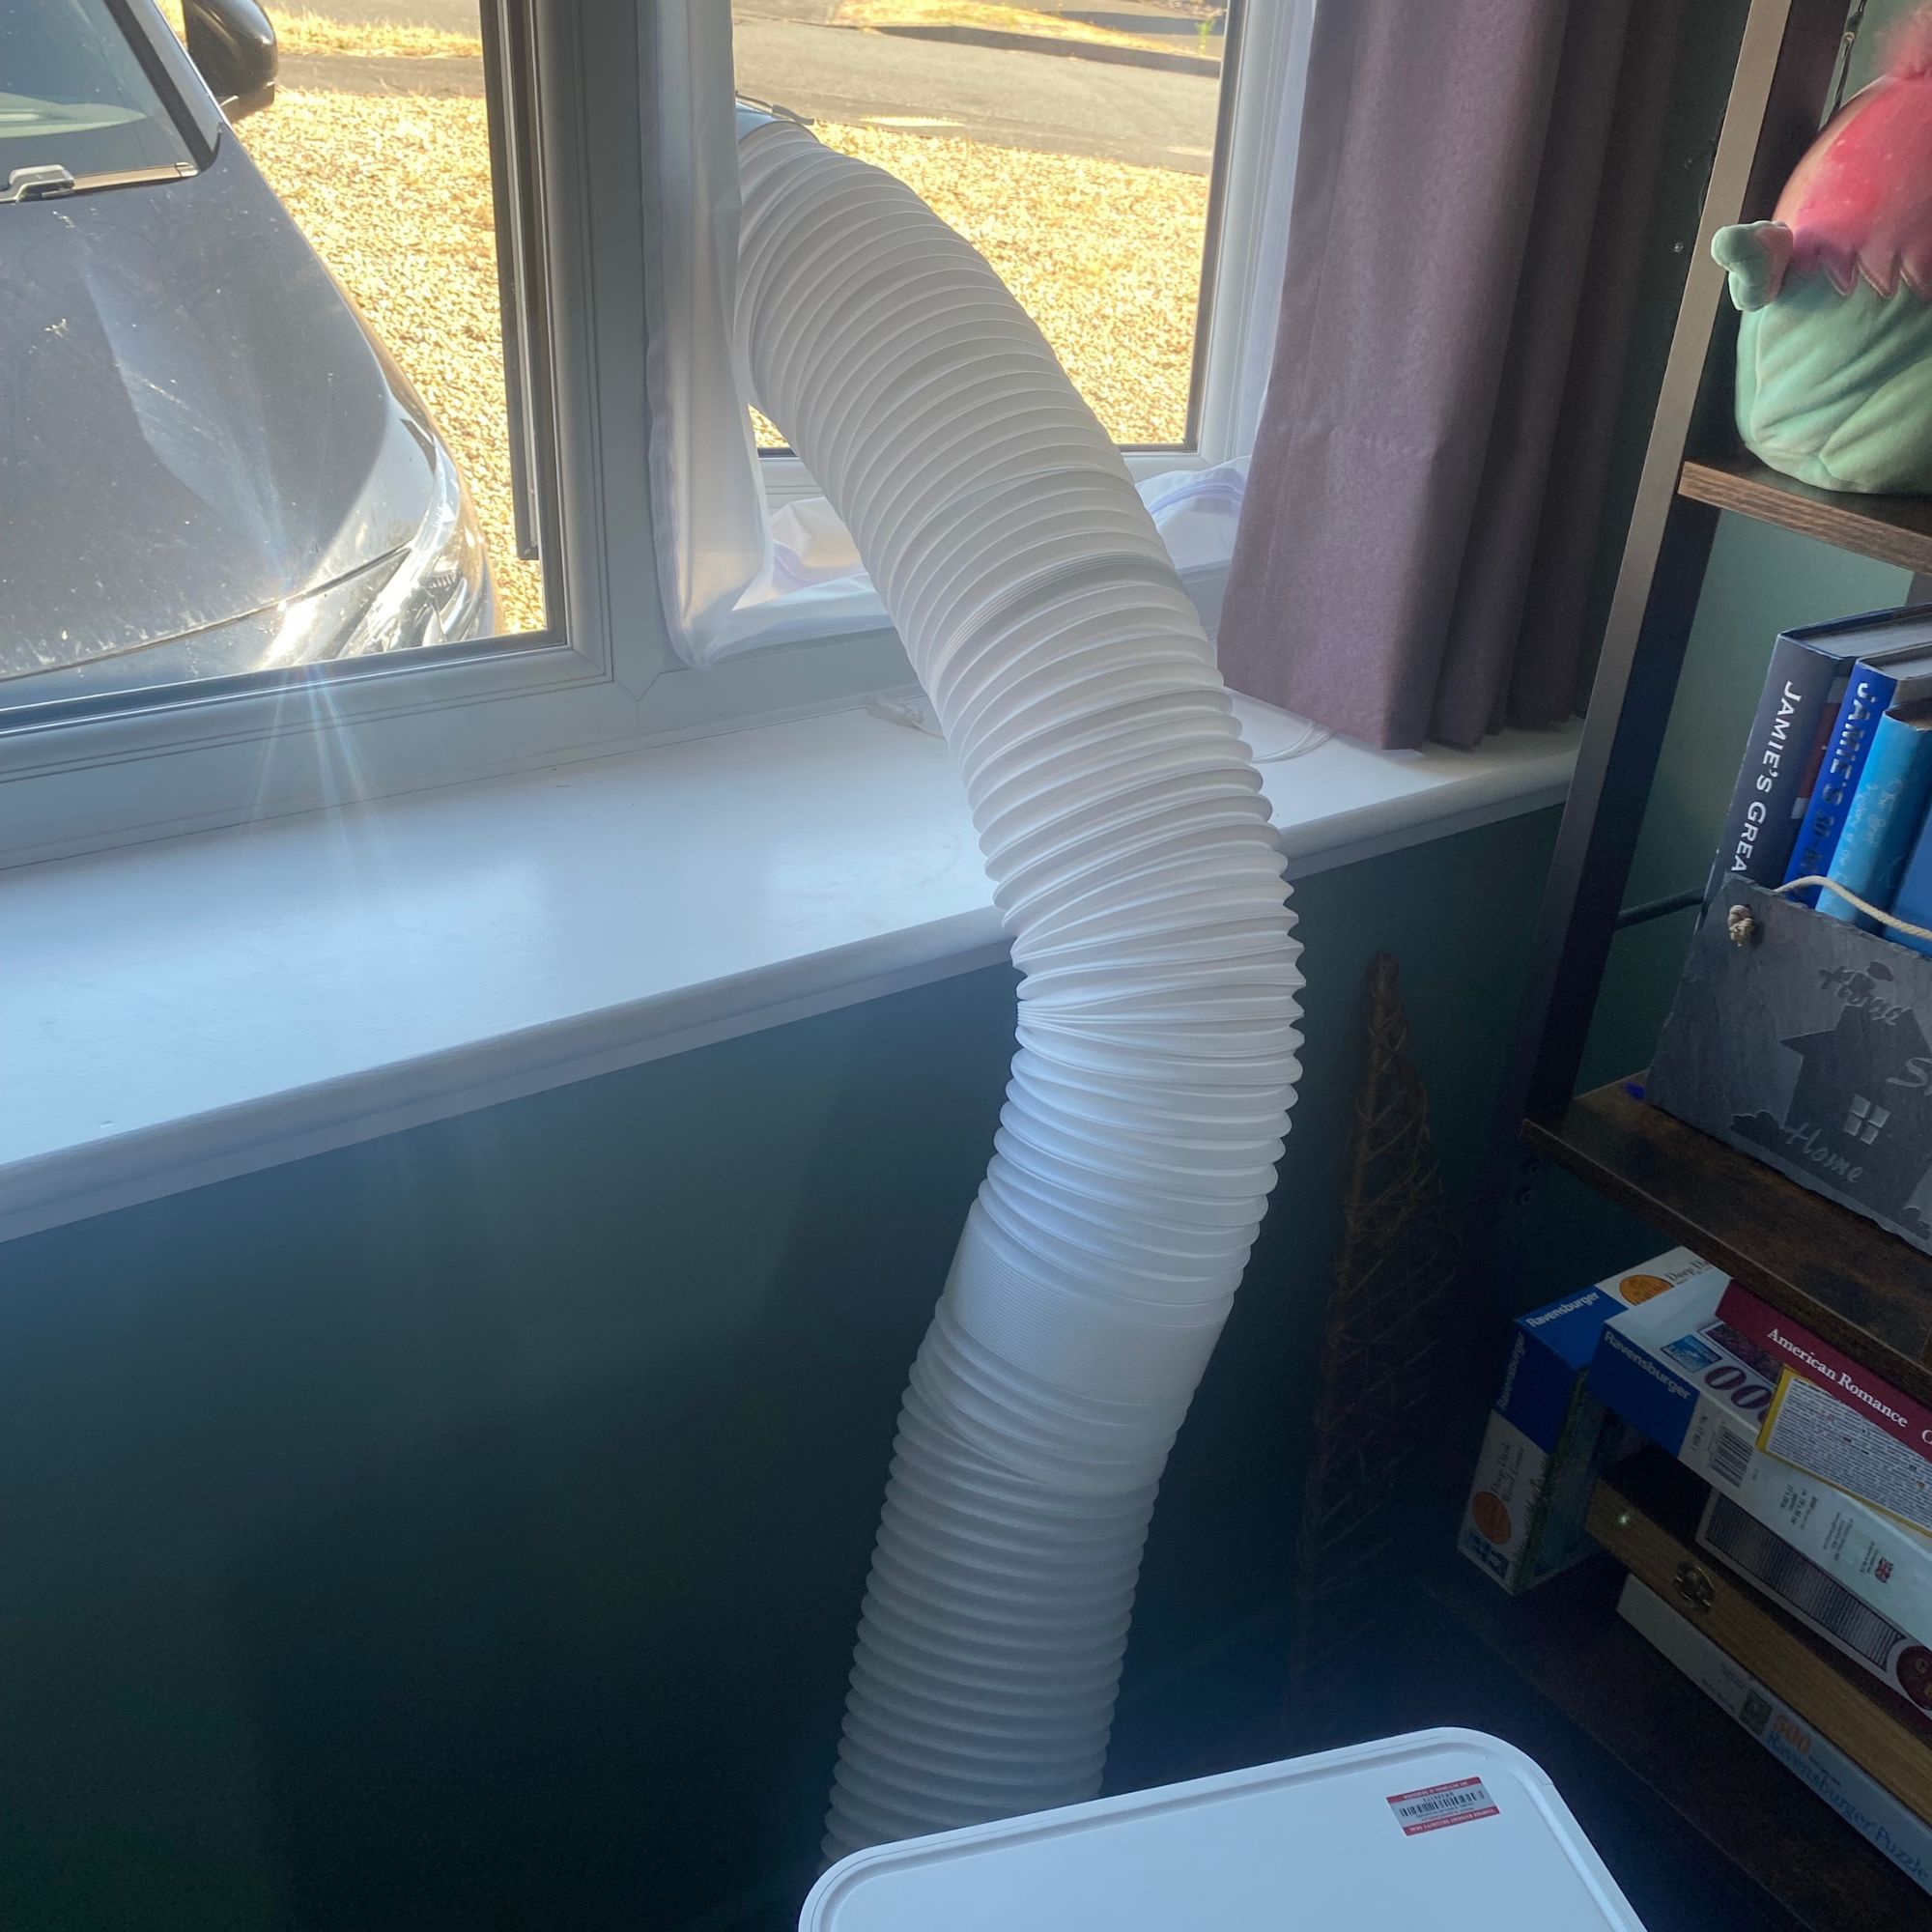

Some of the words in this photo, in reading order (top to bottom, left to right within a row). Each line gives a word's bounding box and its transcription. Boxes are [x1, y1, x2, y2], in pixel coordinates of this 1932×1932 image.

[1755, 680, 1803, 794] JAMIE'S
[1822, 681, 1877, 808] JAMIE'S
[1730, 800, 1767, 872] GREA
[1786, 1122, 1864, 1183] Home
[1525, 1291, 1600, 1328] Ravensburger
[1604, 1330, 1690, 1400] Ravensburger
[1767, 1327, 1836, 1381] American
[1837, 1374, 1909, 1428] Romance
